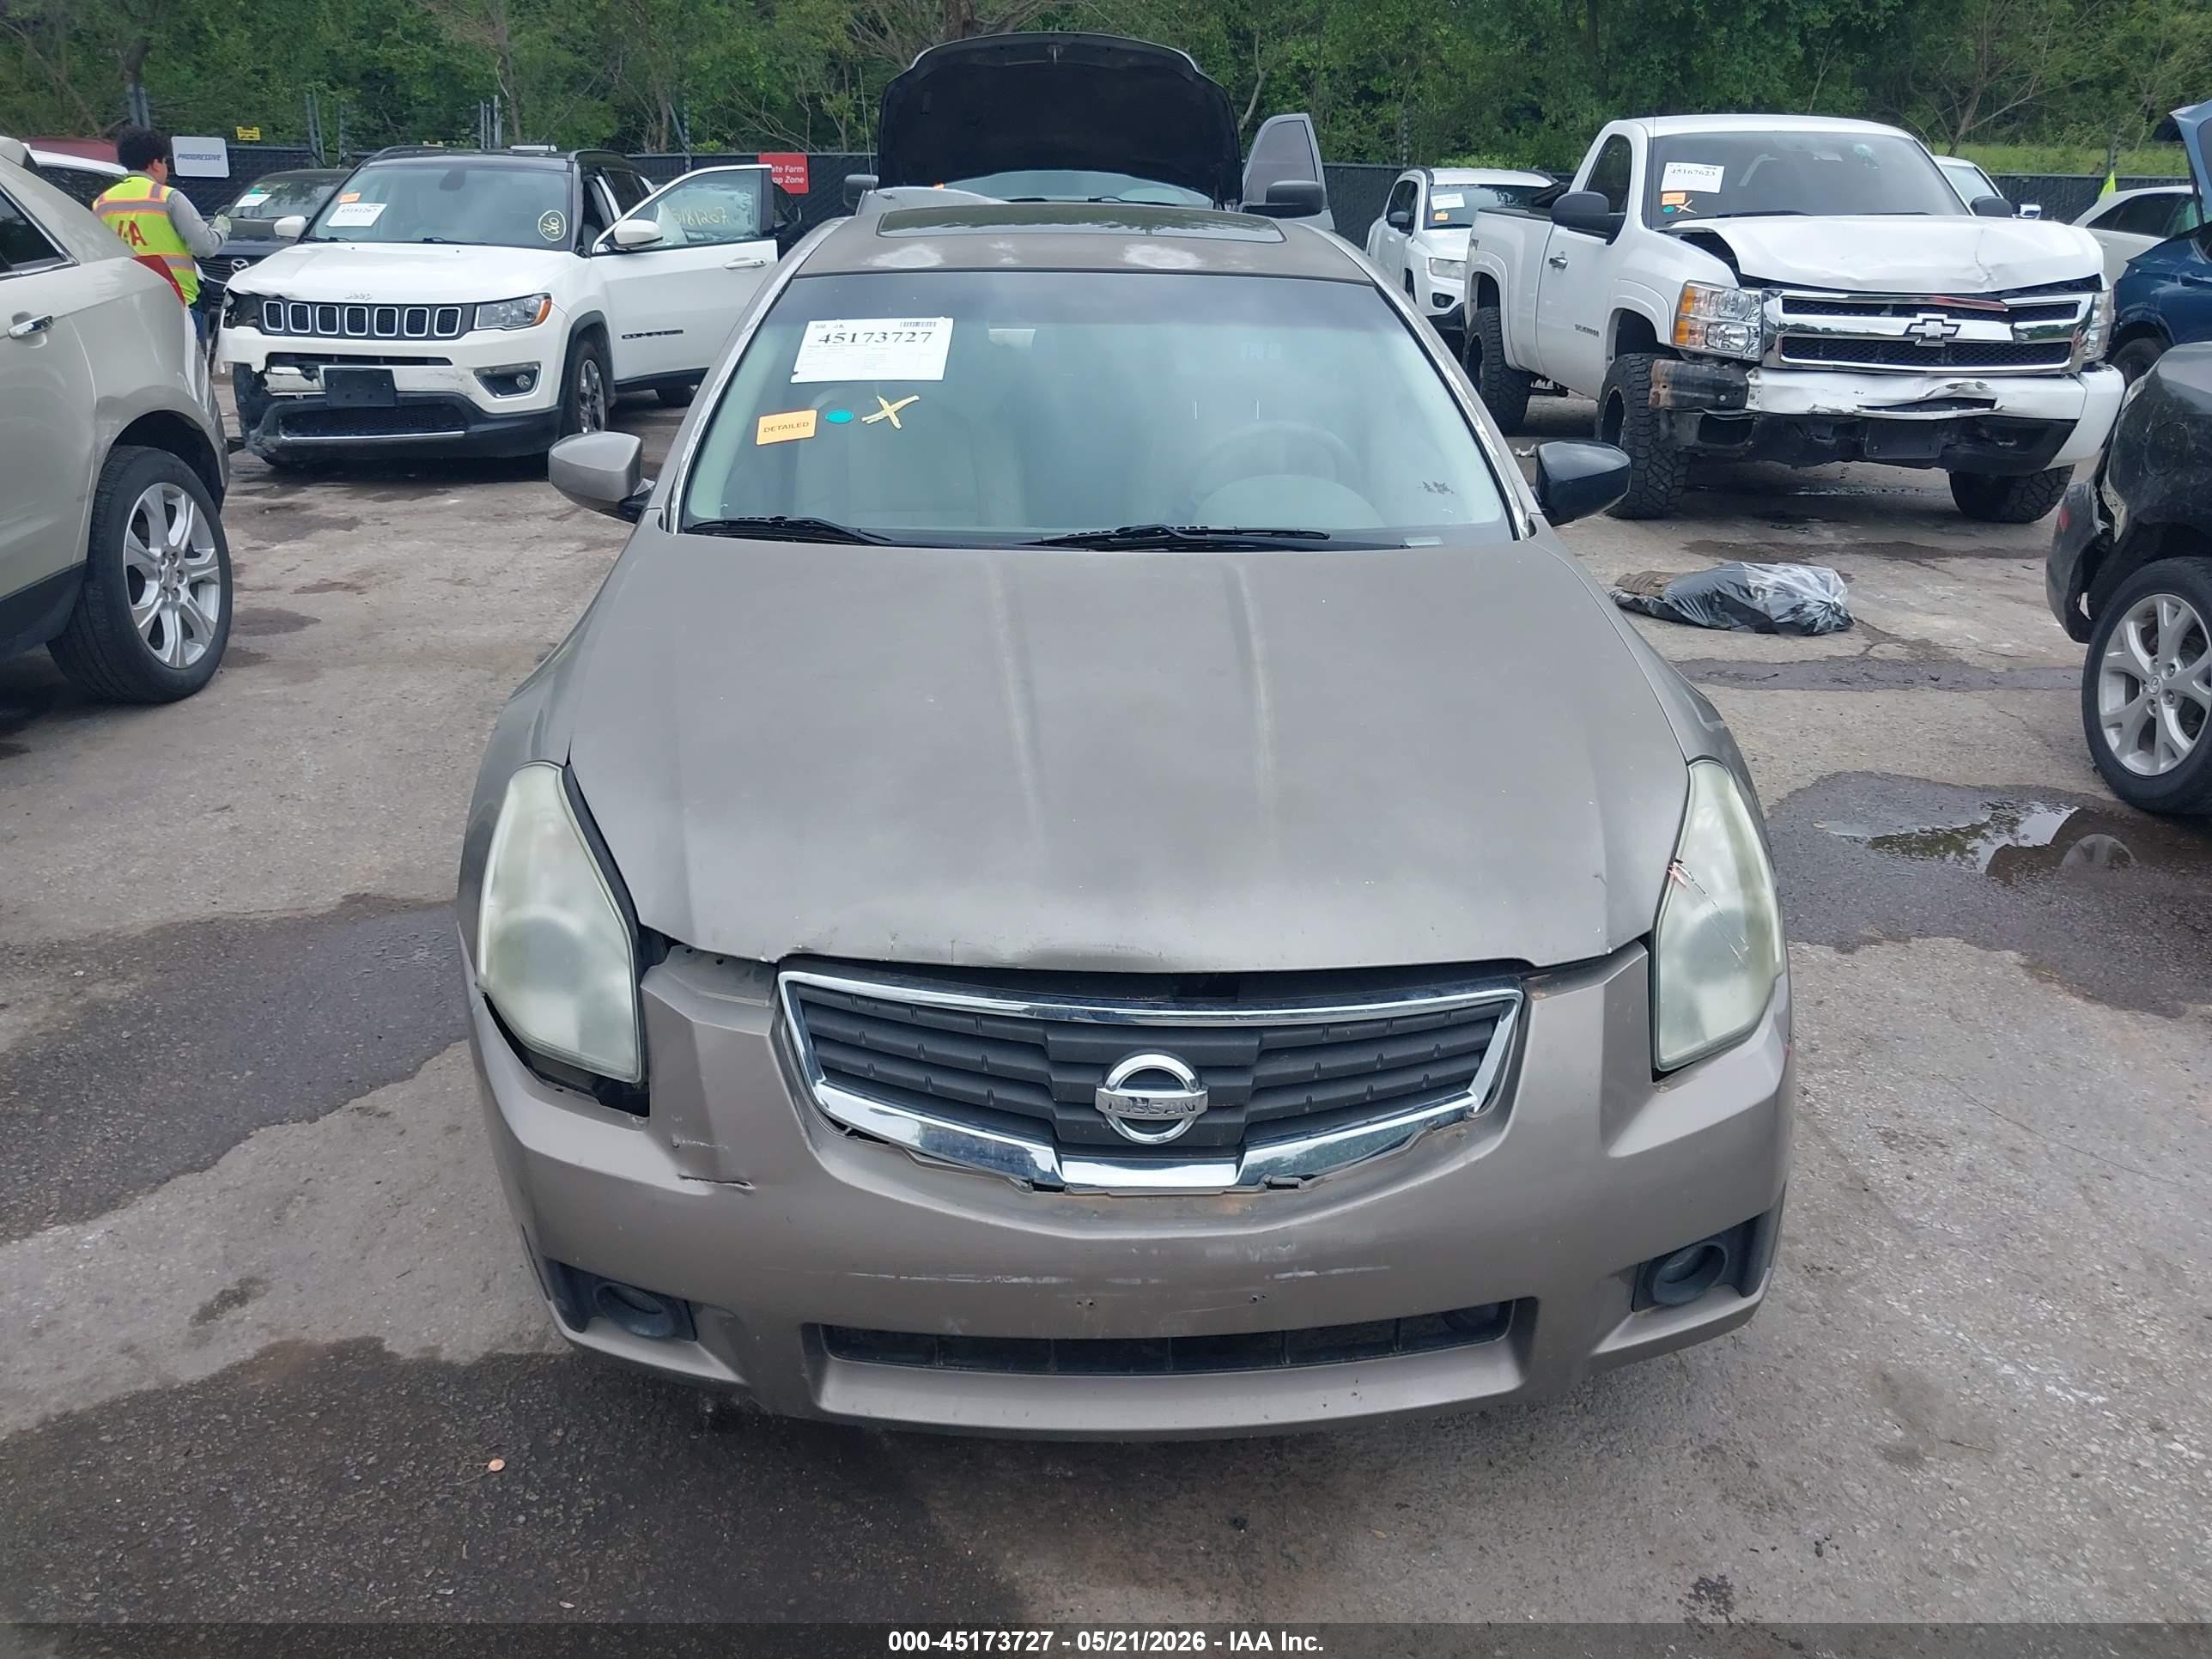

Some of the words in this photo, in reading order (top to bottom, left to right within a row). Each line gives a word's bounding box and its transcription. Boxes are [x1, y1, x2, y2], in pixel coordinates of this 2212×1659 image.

[785, 165, 805, 173] Farm
[818, 331, 933, 344] 45173727
[763, 421, 810, 434] DETAILED
[1107, 1096, 1197, 1115] NISSAN
